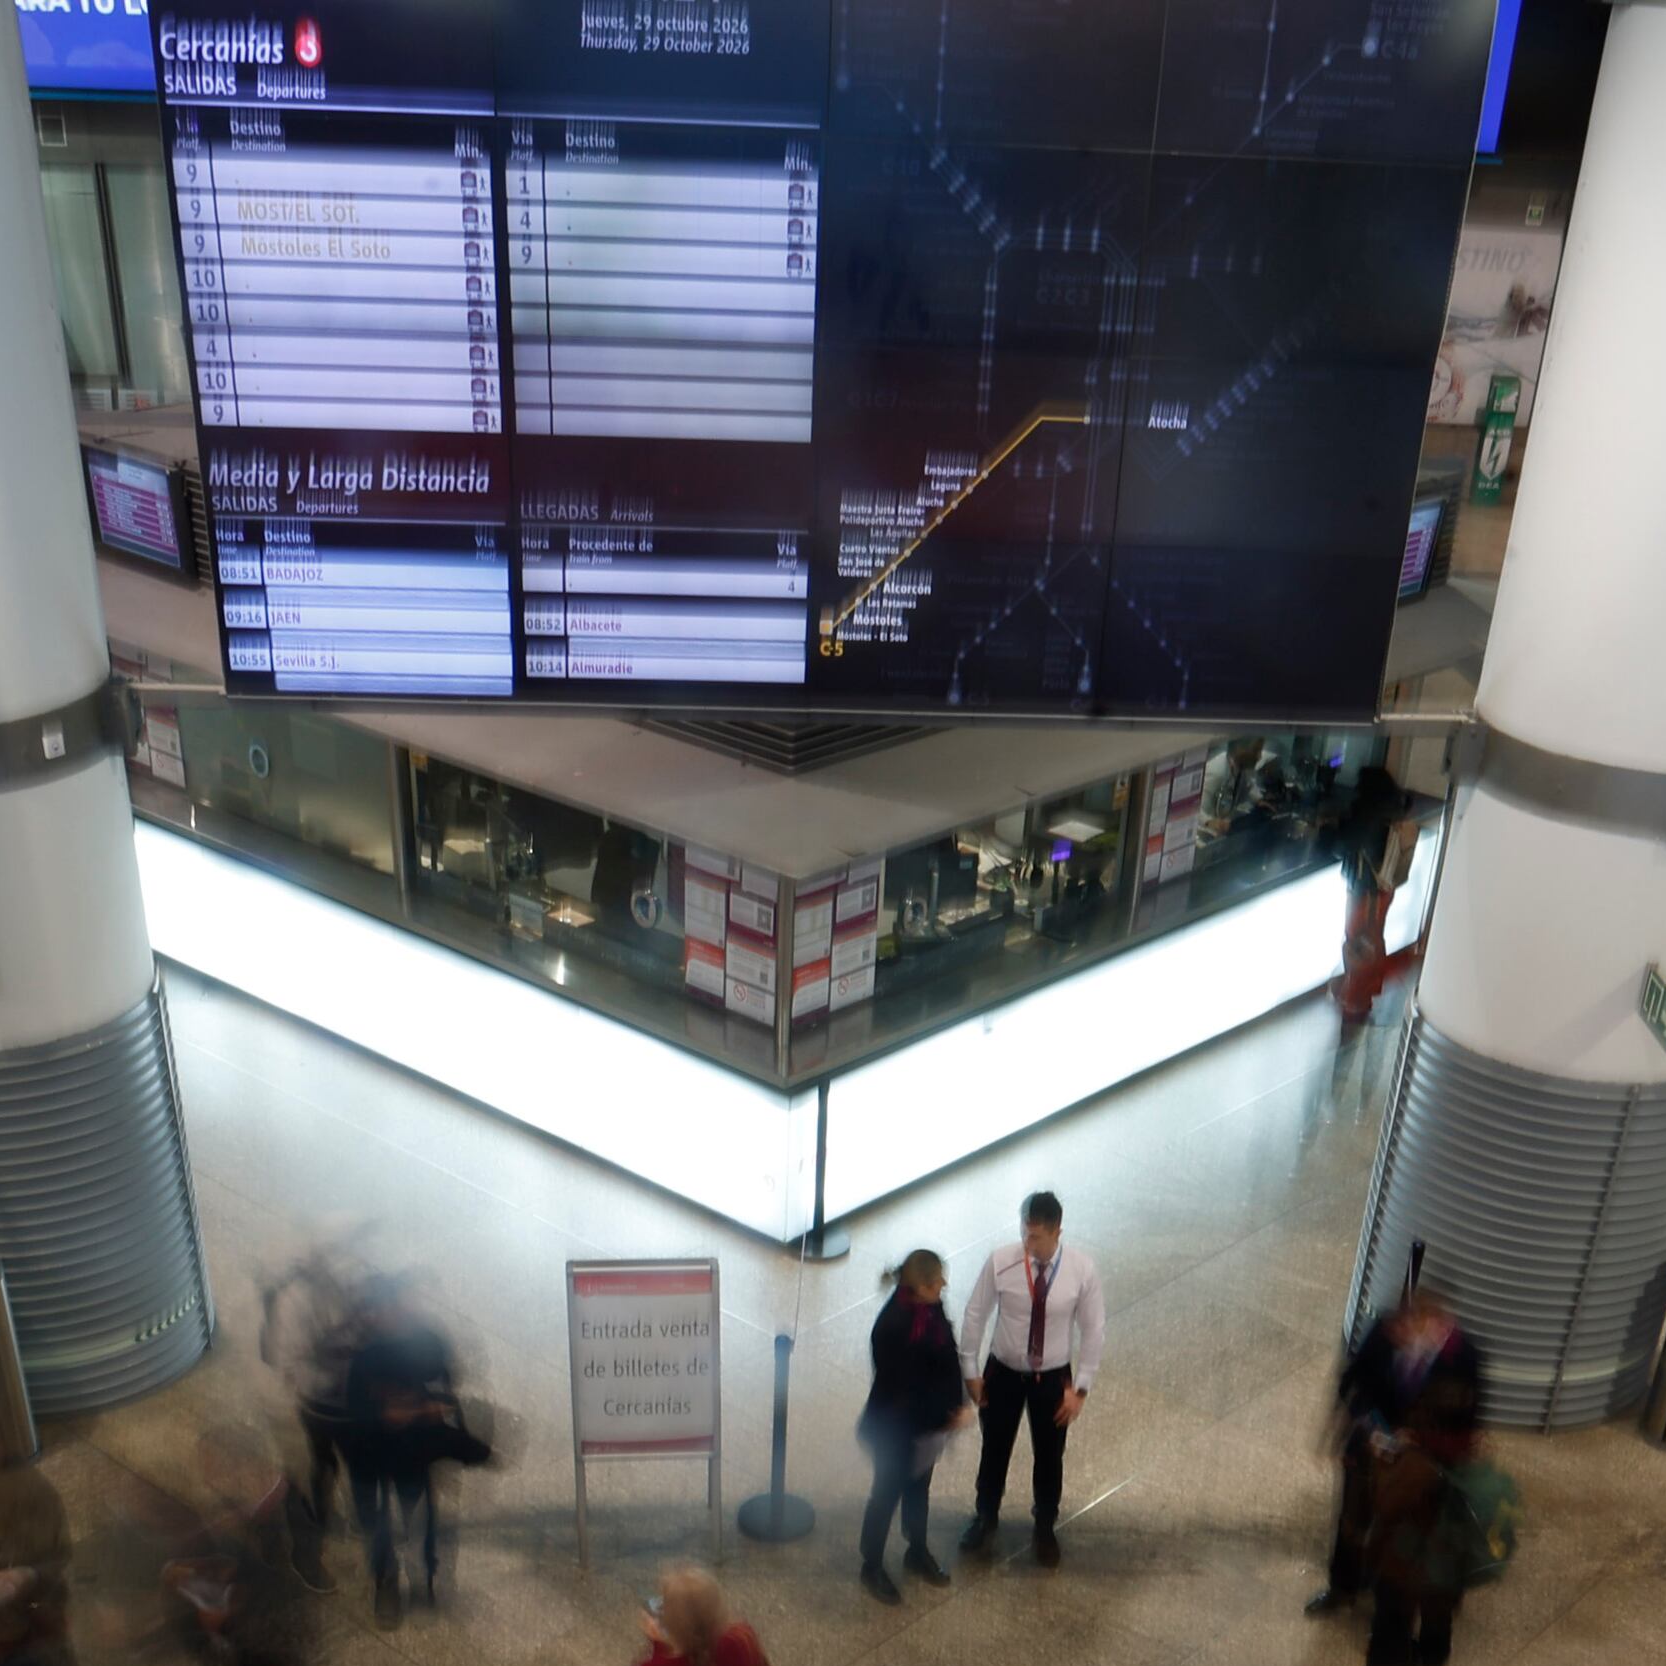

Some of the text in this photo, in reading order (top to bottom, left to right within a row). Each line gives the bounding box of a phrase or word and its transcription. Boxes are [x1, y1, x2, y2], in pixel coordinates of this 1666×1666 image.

[634, 15, 652, 30] 29
[656, 16, 709, 32] octubre
[713, 18, 749, 34] 2026
[160, 32, 284, 65] Cercanías
[643, 37, 660, 51] 29
[664, 37, 712, 54] October
[716, 40, 749, 54] 2026
[164, 74, 326, 101] SALIDAS Departures
[230, 120, 281, 136] Destino
[231, 138, 286, 152] Destination
[565, 132, 615, 148] Destino
[565, 151, 619, 165] Destination
[186, 165, 197, 184] 9
[519, 176, 530, 195] 1
[191, 201, 201, 219] 9
[520, 211, 531, 230] 4
[194, 235, 205, 253] 9
[328, 239, 342, 258] El
[351, 239, 391, 259] Soto
[522, 246, 532, 264] 9
[193, 269, 216, 287] 10
[197, 303, 219, 321] 10
[206, 340, 217, 357] 4
[204, 372, 227, 390] 10
[214, 405, 224, 423] 9
[1148, 416, 1188, 430] Atocha
[924, 465, 977, 477] Embajadores
[209, 464, 489, 496] Media y Larga Distancia
[931, 480, 961, 493] Laguna
[213, 496, 359, 516] SALIDAS Departures
[840, 503, 872, 515] Maestra
[874, 504, 895, 515] Justa
[916, 496, 944, 508] Aluche
[520, 503, 654, 522] LLEGADAS Arrivals
[840, 514, 925, 527] Polideportivo Aluche
[216, 529, 244, 542] Hora
[264, 530, 311, 543] Destino
[521, 537, 550, 550] Hora
[569, 538, 653, 553] Procedente de
[839, 543, 899, 555] Cuatro Vientos
[838, 556, 885, 568] San José de
[221, 566, 258, 580] 08:51
[267, 567, 323, 582] BADAJOZ
[837, 566, 872, 577] Valderas
[787, 581, 795, 593] 4
[883, 582, 931, 595] Alcorcón
[867, 598, 916, 609] Las Retamas
[226, 611, 262, 624] 09:16
[526, 618, 562, 631] 08:52
[853, 613, 902, 626] Móstoles
[570, 618, 622, 632] Albacete
[836, 631, 872, 642] Móstoles
[890, 632, 909, 643] Soto
[232, 653, 267, 666] 10:55
[275, 654, 316, 668] Sevilla
[528, 661, 563, 674] 10:14
[571, 660, 633, 674] Almuradie
[582, 1320, 711, 1340] Entrada venta
[584, 1357, 710, 1379] de billetes de
[603, 1397, 692, 1417] Cercanías
